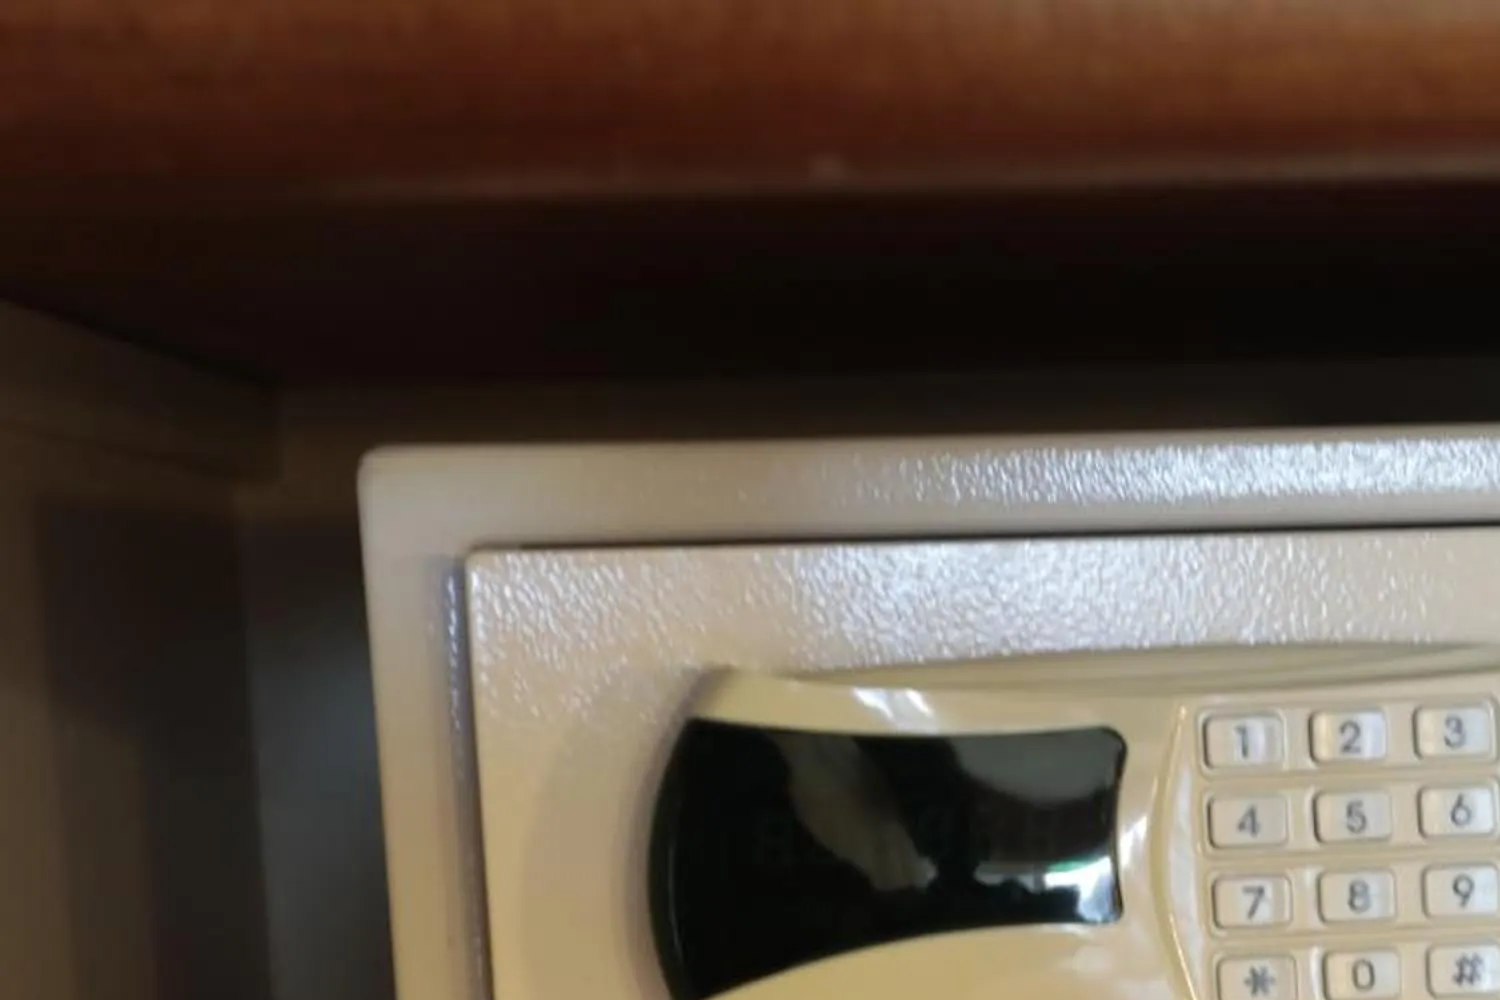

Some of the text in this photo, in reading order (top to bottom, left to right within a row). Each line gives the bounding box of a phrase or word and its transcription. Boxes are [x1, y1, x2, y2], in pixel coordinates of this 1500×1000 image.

[1234, 715, 1467, 758] 1 2 3
[1236, 793, 1473, 838] 4 5 6
[1242, 873, 1476, 920] 7 8 9
[1351, 958, 1376, 991] 0
[1452, 952, 1484, 987] #
